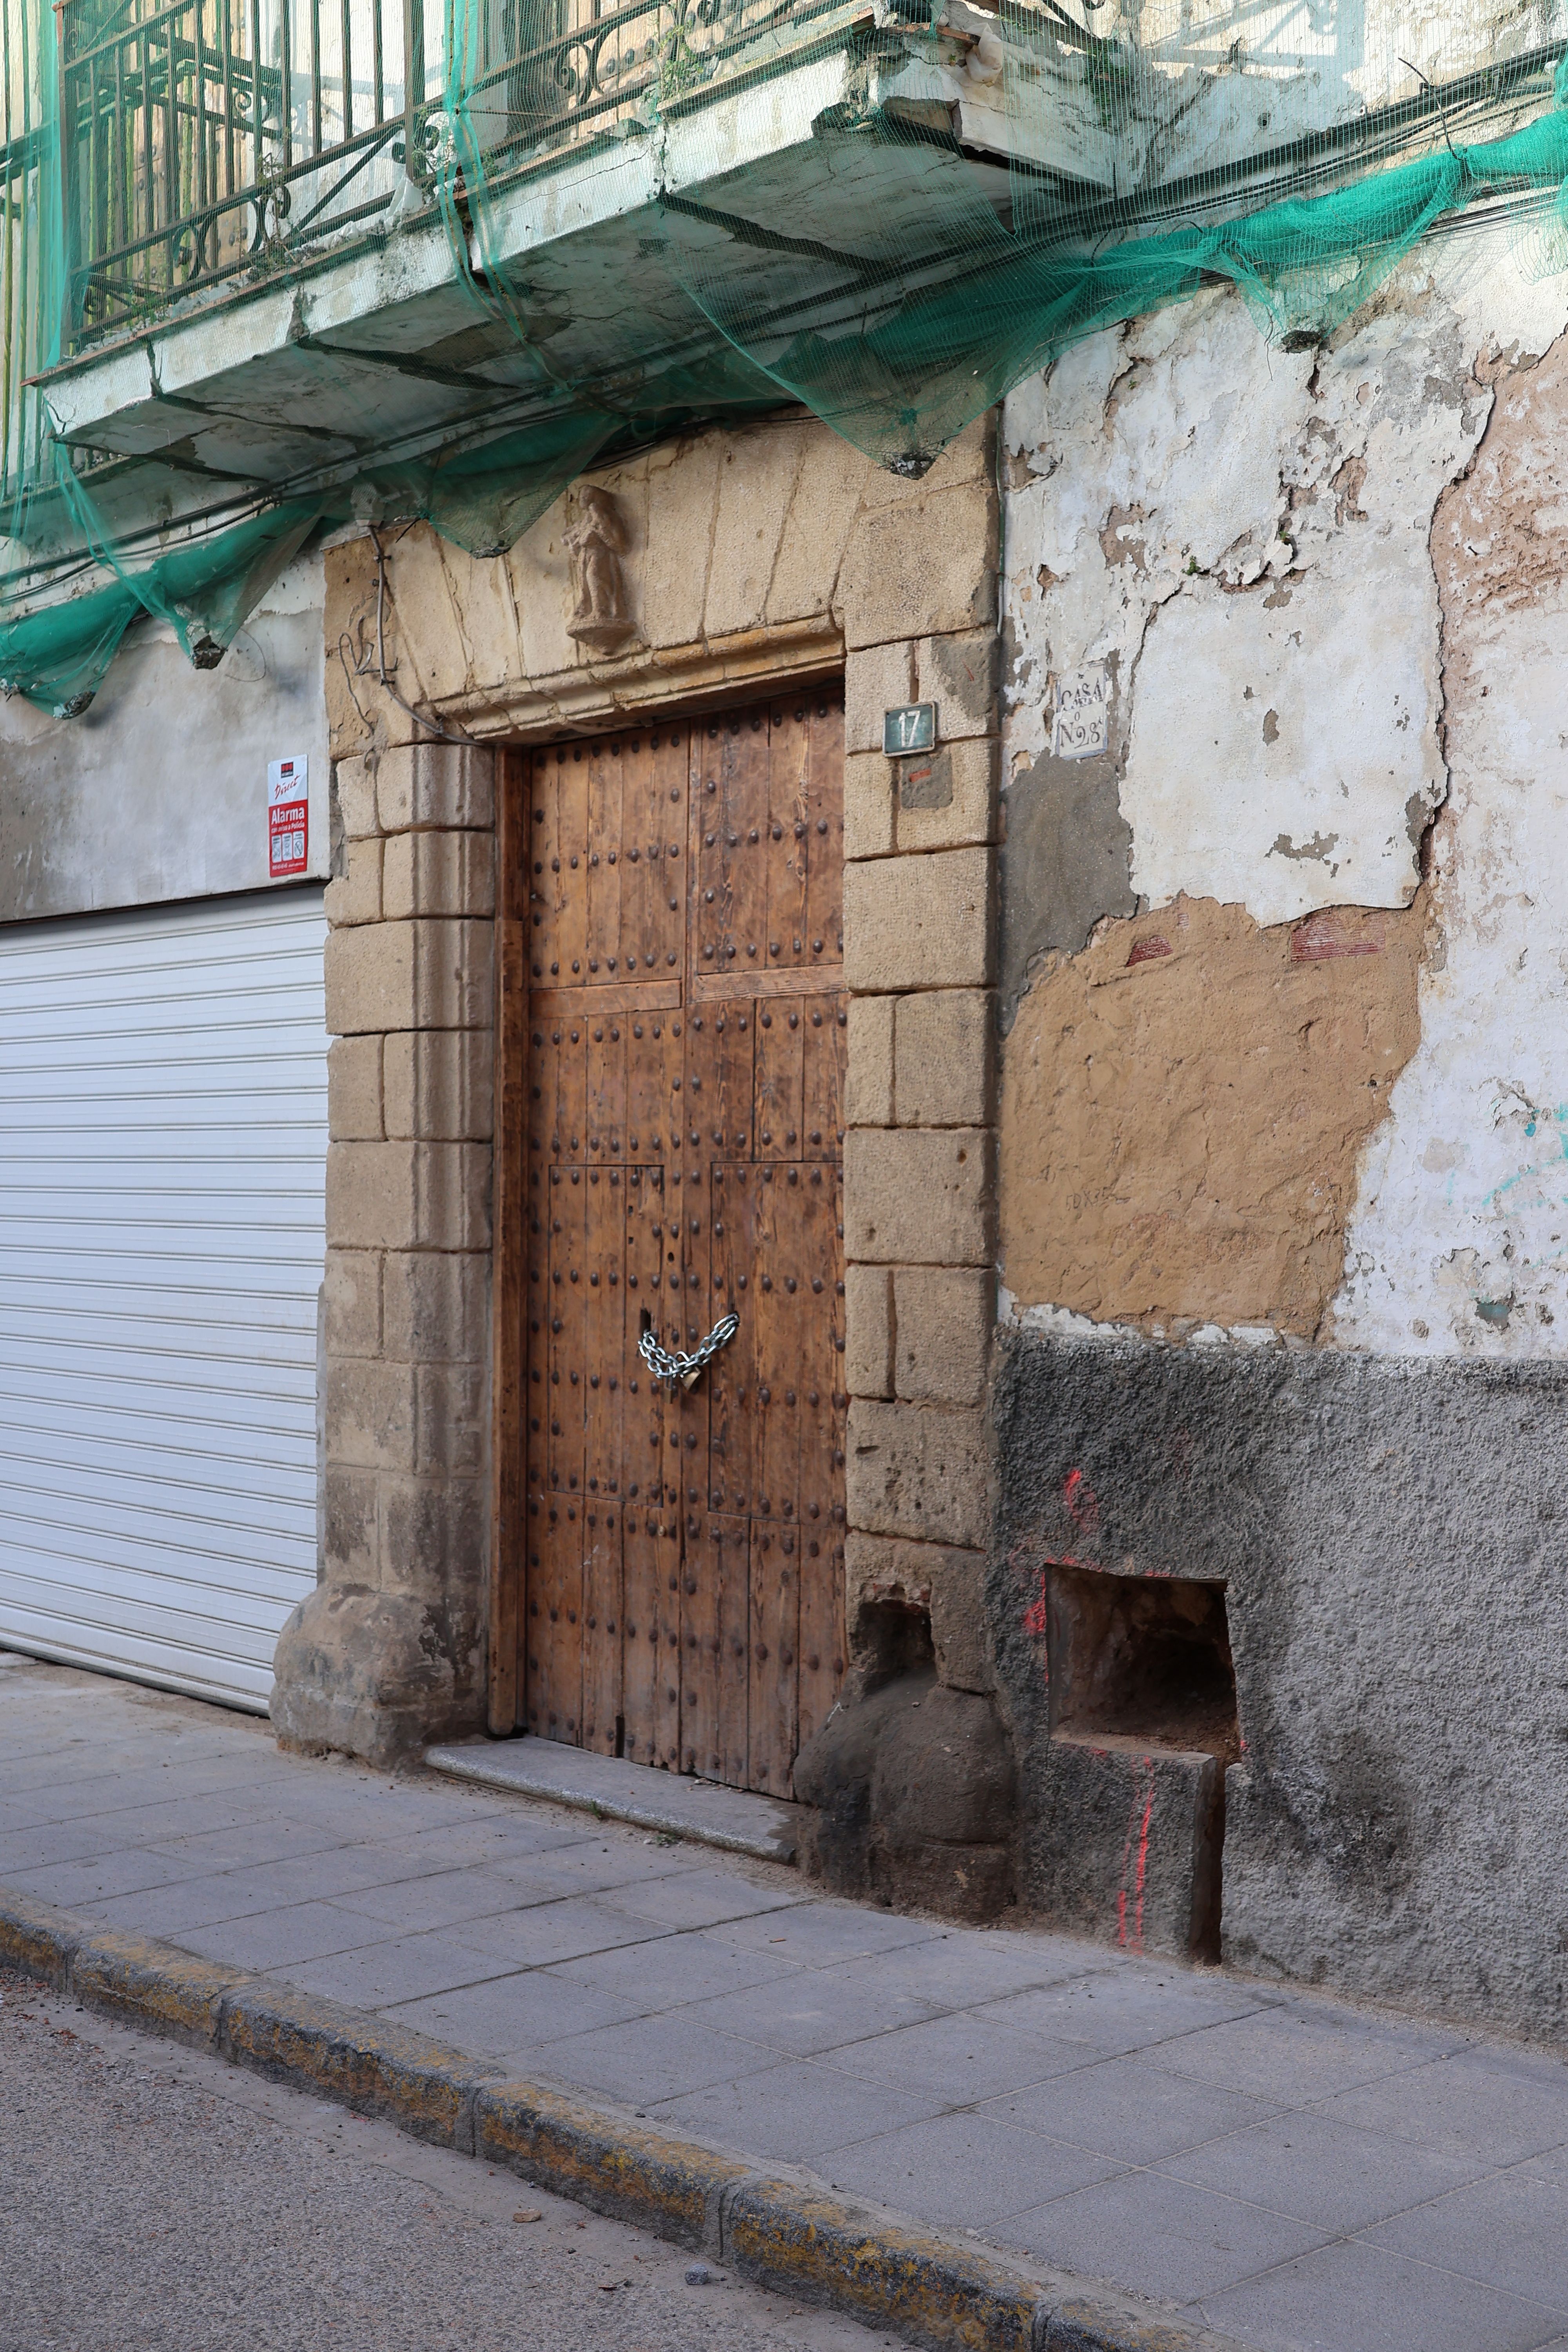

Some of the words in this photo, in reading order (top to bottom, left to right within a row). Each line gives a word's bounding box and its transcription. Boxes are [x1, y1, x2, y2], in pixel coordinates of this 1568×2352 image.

[1061, 677, 1103, 711] CASA
[898, 710, 921, 748] 17
[1074, 722, 1100, 749] 28
[274, 773, 301, 800] Direct
[271, 806, 305, 825] Alarma
